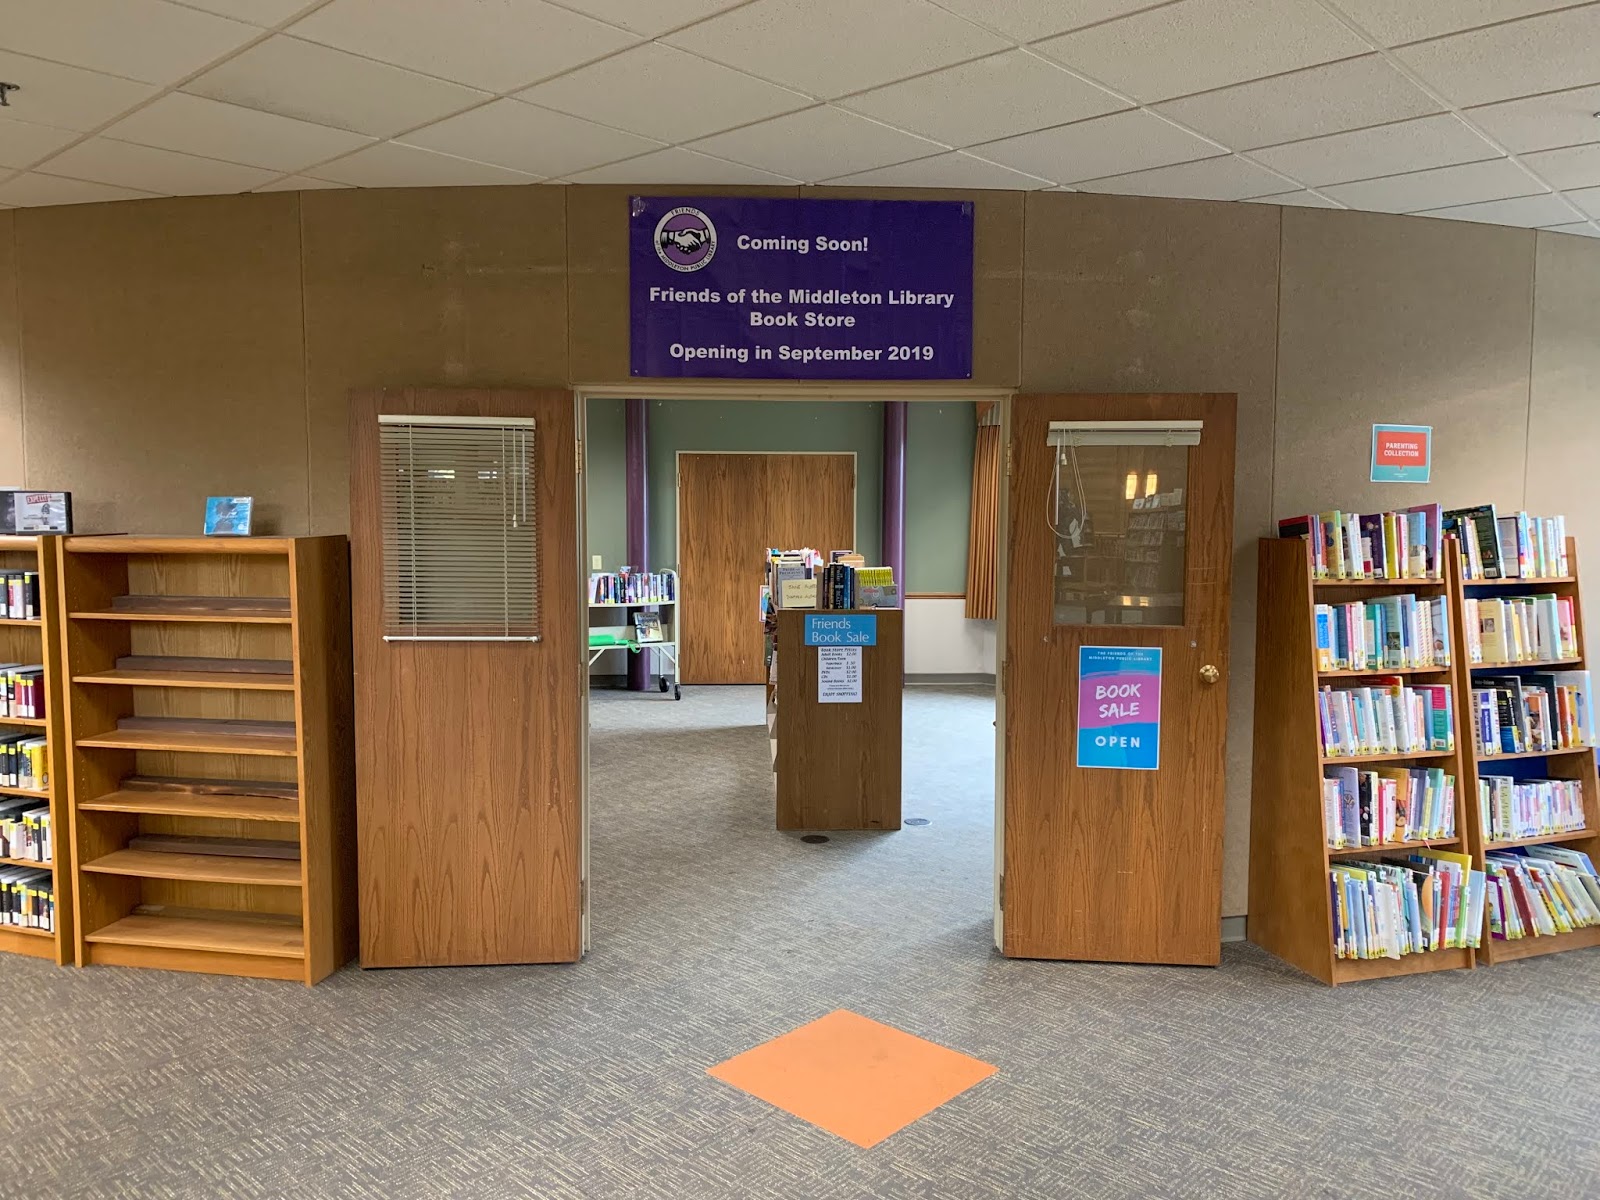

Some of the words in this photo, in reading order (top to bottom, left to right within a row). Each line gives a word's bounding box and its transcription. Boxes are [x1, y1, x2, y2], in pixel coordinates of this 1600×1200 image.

[670, 207, 700, 216] FRIENDS
[737, 235, 809, 254] Coming
[816, 236, 868, 252] Soon!
[660, 254, 689, 271] MIDDLETON
[690, 259, 708, 271] PUBLIC
[705, 240, 716, 261] LIBRARY
[649, 287, 720, 303] Friends
[727, 288, 746, 304] of
[751, 288, 782, 304] the
[788, 289, 882, 305] Middleton
[888, 290, 954, 308] Library
[750, 311, 798, 327] Book
[804, 312, 855, 328] Store
[669, 343, 749, 363] Opening
[755, 344, 772, 360] in
[778, 345, 882, 364] September
[887, 346, 934, 361] 2019
[1383, 449, 1419, 457] COLLECTION
[812, 617, 851, 629] Friends
[812, 631, 842, 643] Book
[846, 631, 870, 643] Sale
[1095, 683, 1142, 700] BOOK
[1098, 702, 1140, 719] SALE
[1095, 735, 1140, 748] OPEN
